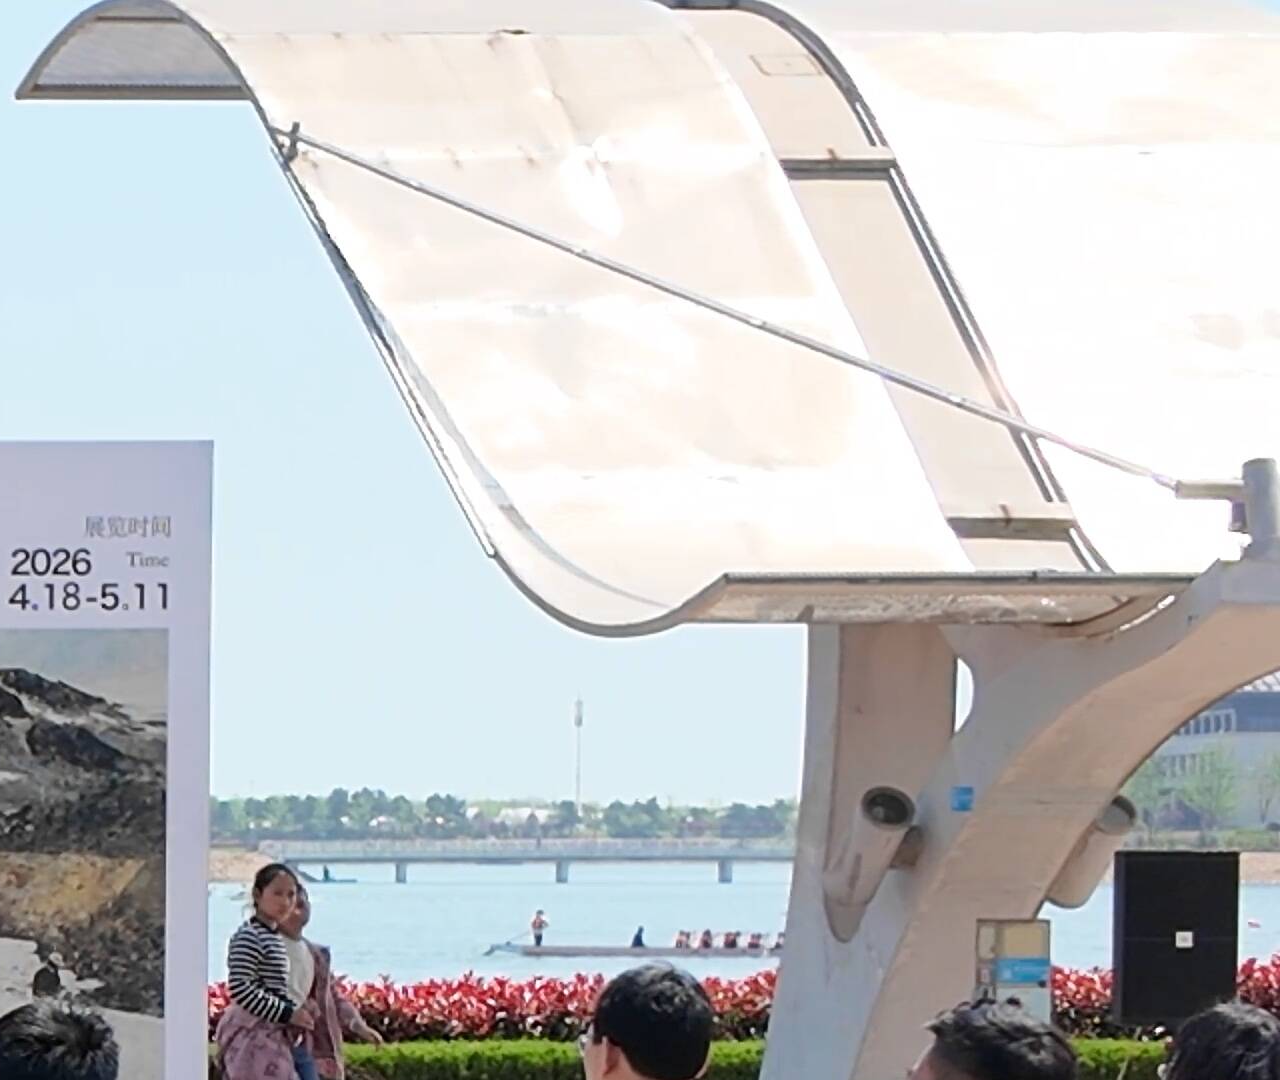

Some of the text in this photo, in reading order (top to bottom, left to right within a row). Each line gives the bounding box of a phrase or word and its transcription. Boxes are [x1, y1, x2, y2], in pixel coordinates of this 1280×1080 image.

[84, 514, 172, 539] 展览时间
[10, 547, 93, 577] 2026
[125, 551, 170, 568] Time
[7, 581, 168, 611] 4.18-5.11
